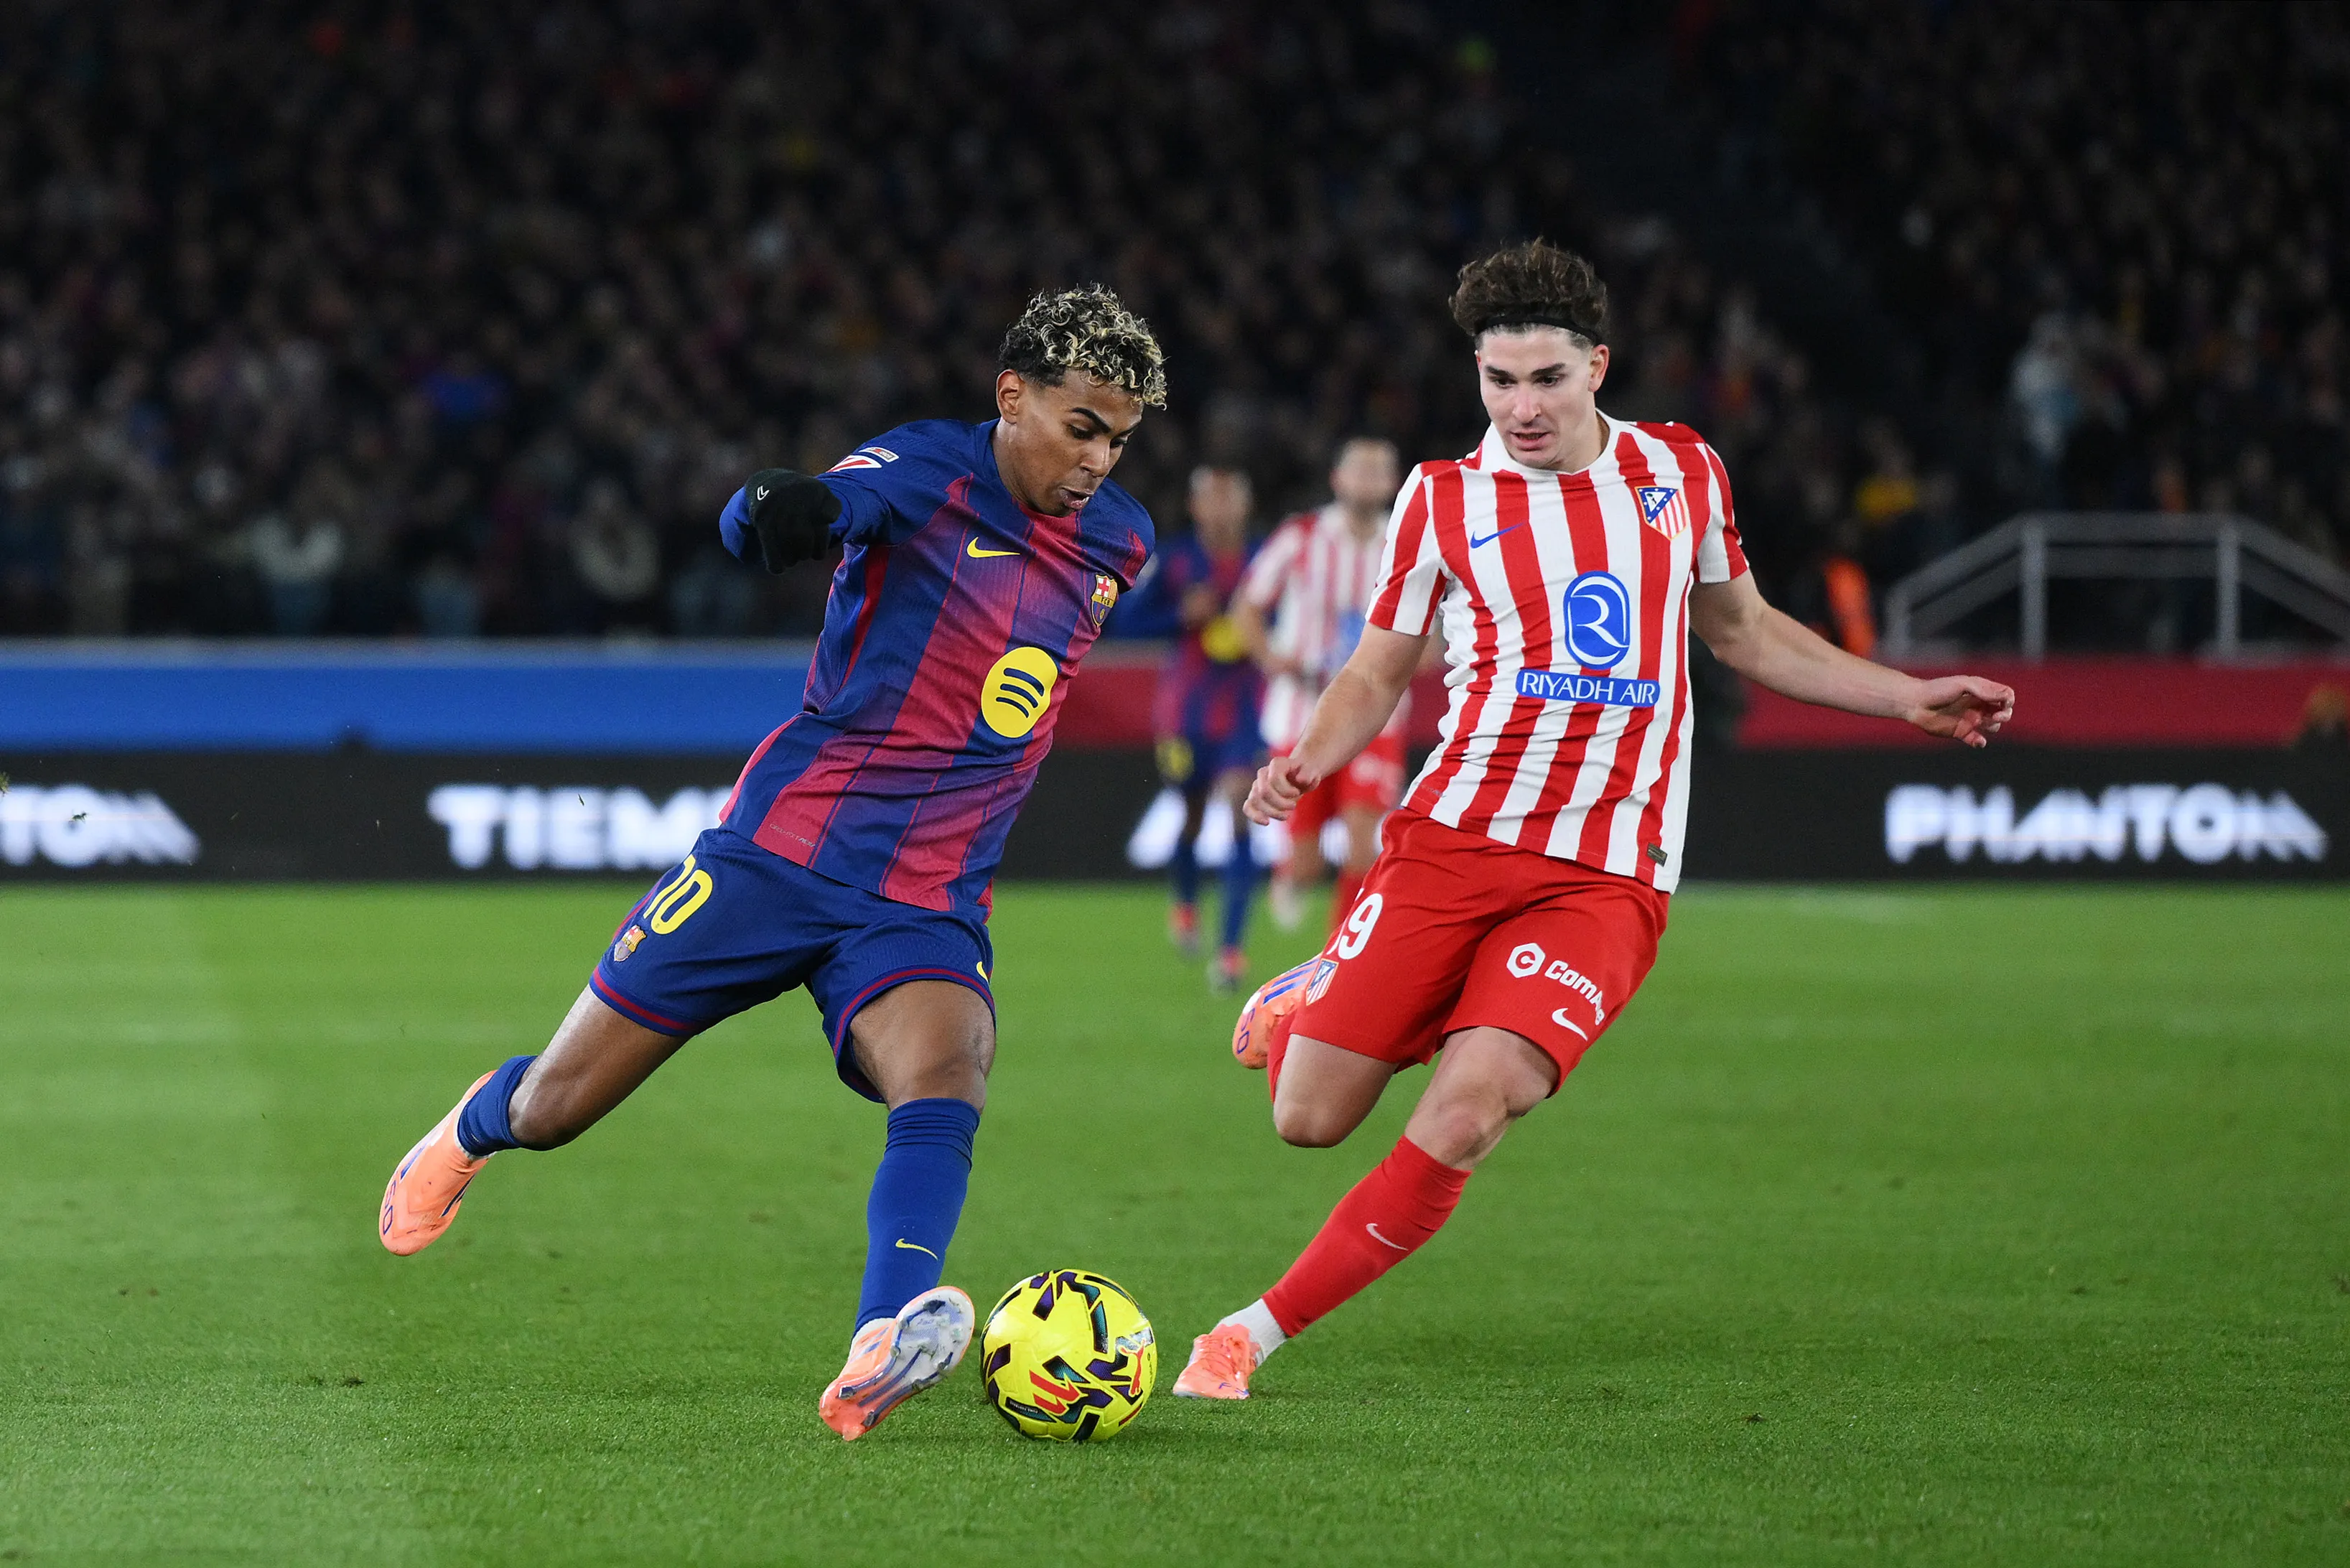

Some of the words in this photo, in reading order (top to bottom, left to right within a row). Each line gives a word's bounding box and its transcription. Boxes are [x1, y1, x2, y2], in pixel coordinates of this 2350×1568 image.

[1521, 672, 1615, 701] RIYADH
[1619, 683, 1656, 704] AIR
[643, 854, 713, 935] 10
